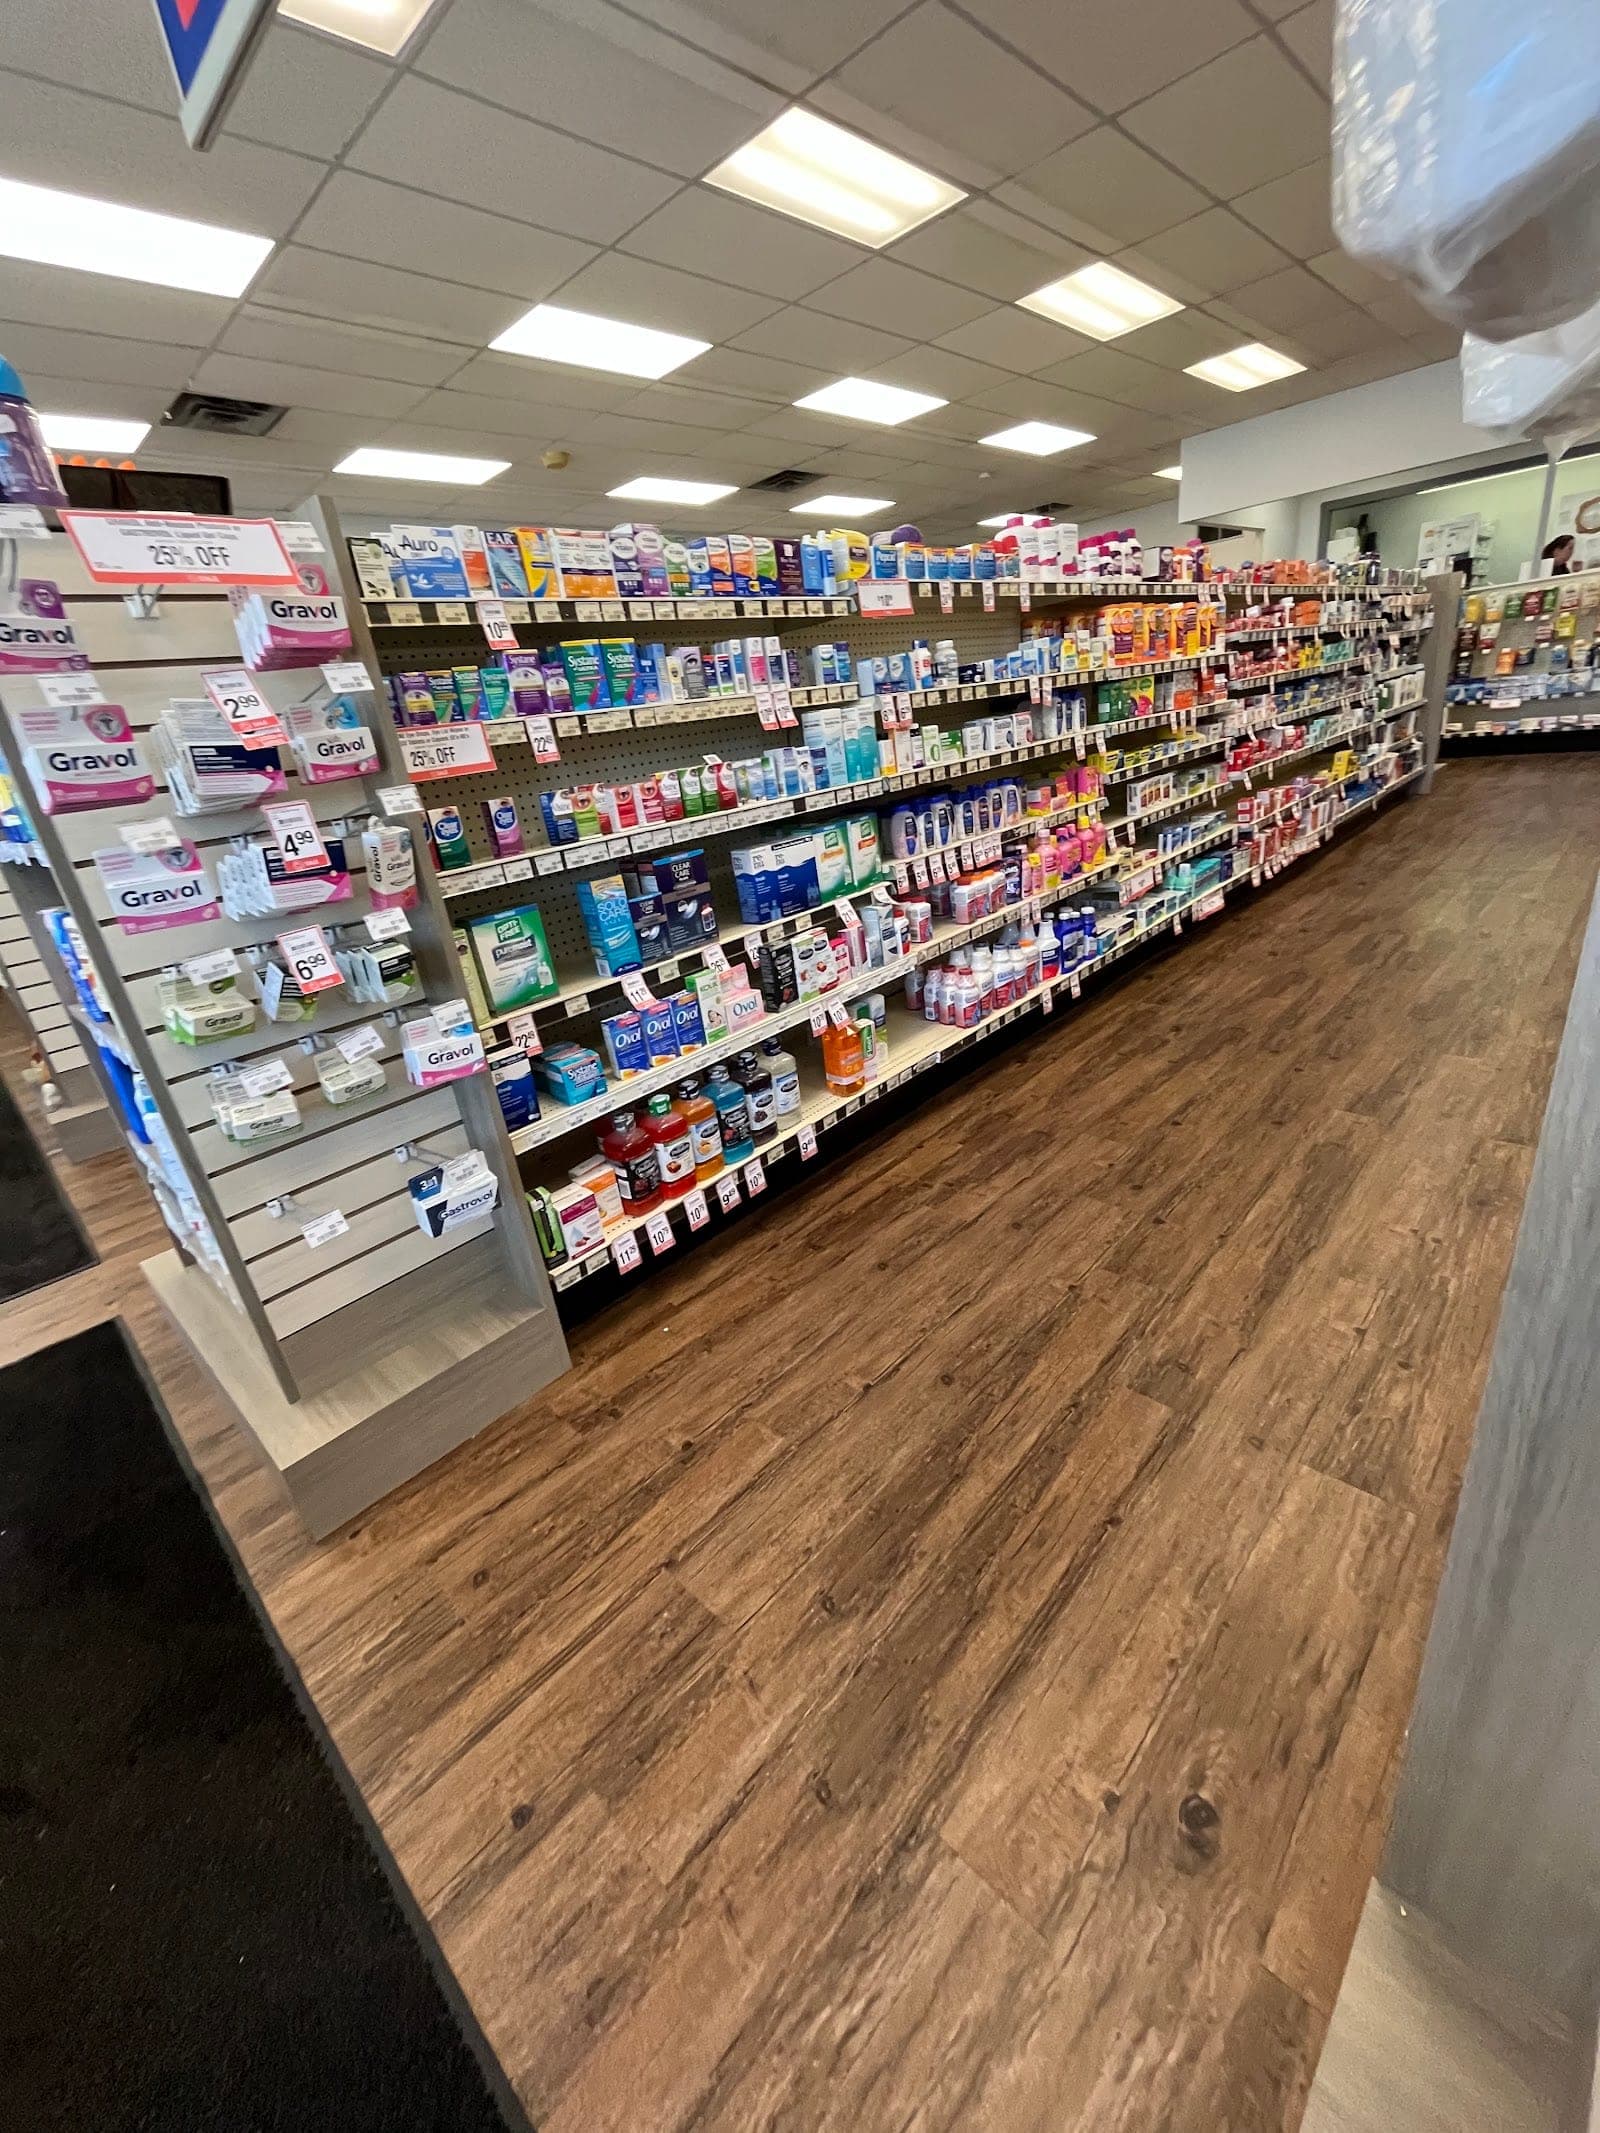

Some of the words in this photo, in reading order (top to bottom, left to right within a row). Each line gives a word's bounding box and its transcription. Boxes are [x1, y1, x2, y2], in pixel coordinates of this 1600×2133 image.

[397, 534, 439, 552] Auro
[486, 532, 514, 545] EAR
[195, 546, 231, 566] OFF
[270, 600, 338, 619] Gravol
[0, 622, 76, 644] Gravol
[317, 736, 365, 757] Gravol
[436, 746, 455, 763] OFF
[49, 747, 138, 772] Gravol
[671, 862, 691, 872] CLEAR
[674, 869, 691, 879] CARE
[121, 880, 202, 908] Gravol
[597, 897, 628, 911] SOLO
[599, 907, 631, 921] CARE
[499, 926, 521, 942] FREE
[676, 1005, 699, 1025] Ovol
[733, 996, 758, 1017] Ovol
[205, 1012, 244, 1028] Gravol
[646, 1015, 672, 1035] Ovol
[615, 1028, 641, 1048] Ovol
[427, 1043, 474, 1065] Gravol
[567, 1062, 598, 1080] Systane
[438, 1189, 494, 1221] Gastrovol
